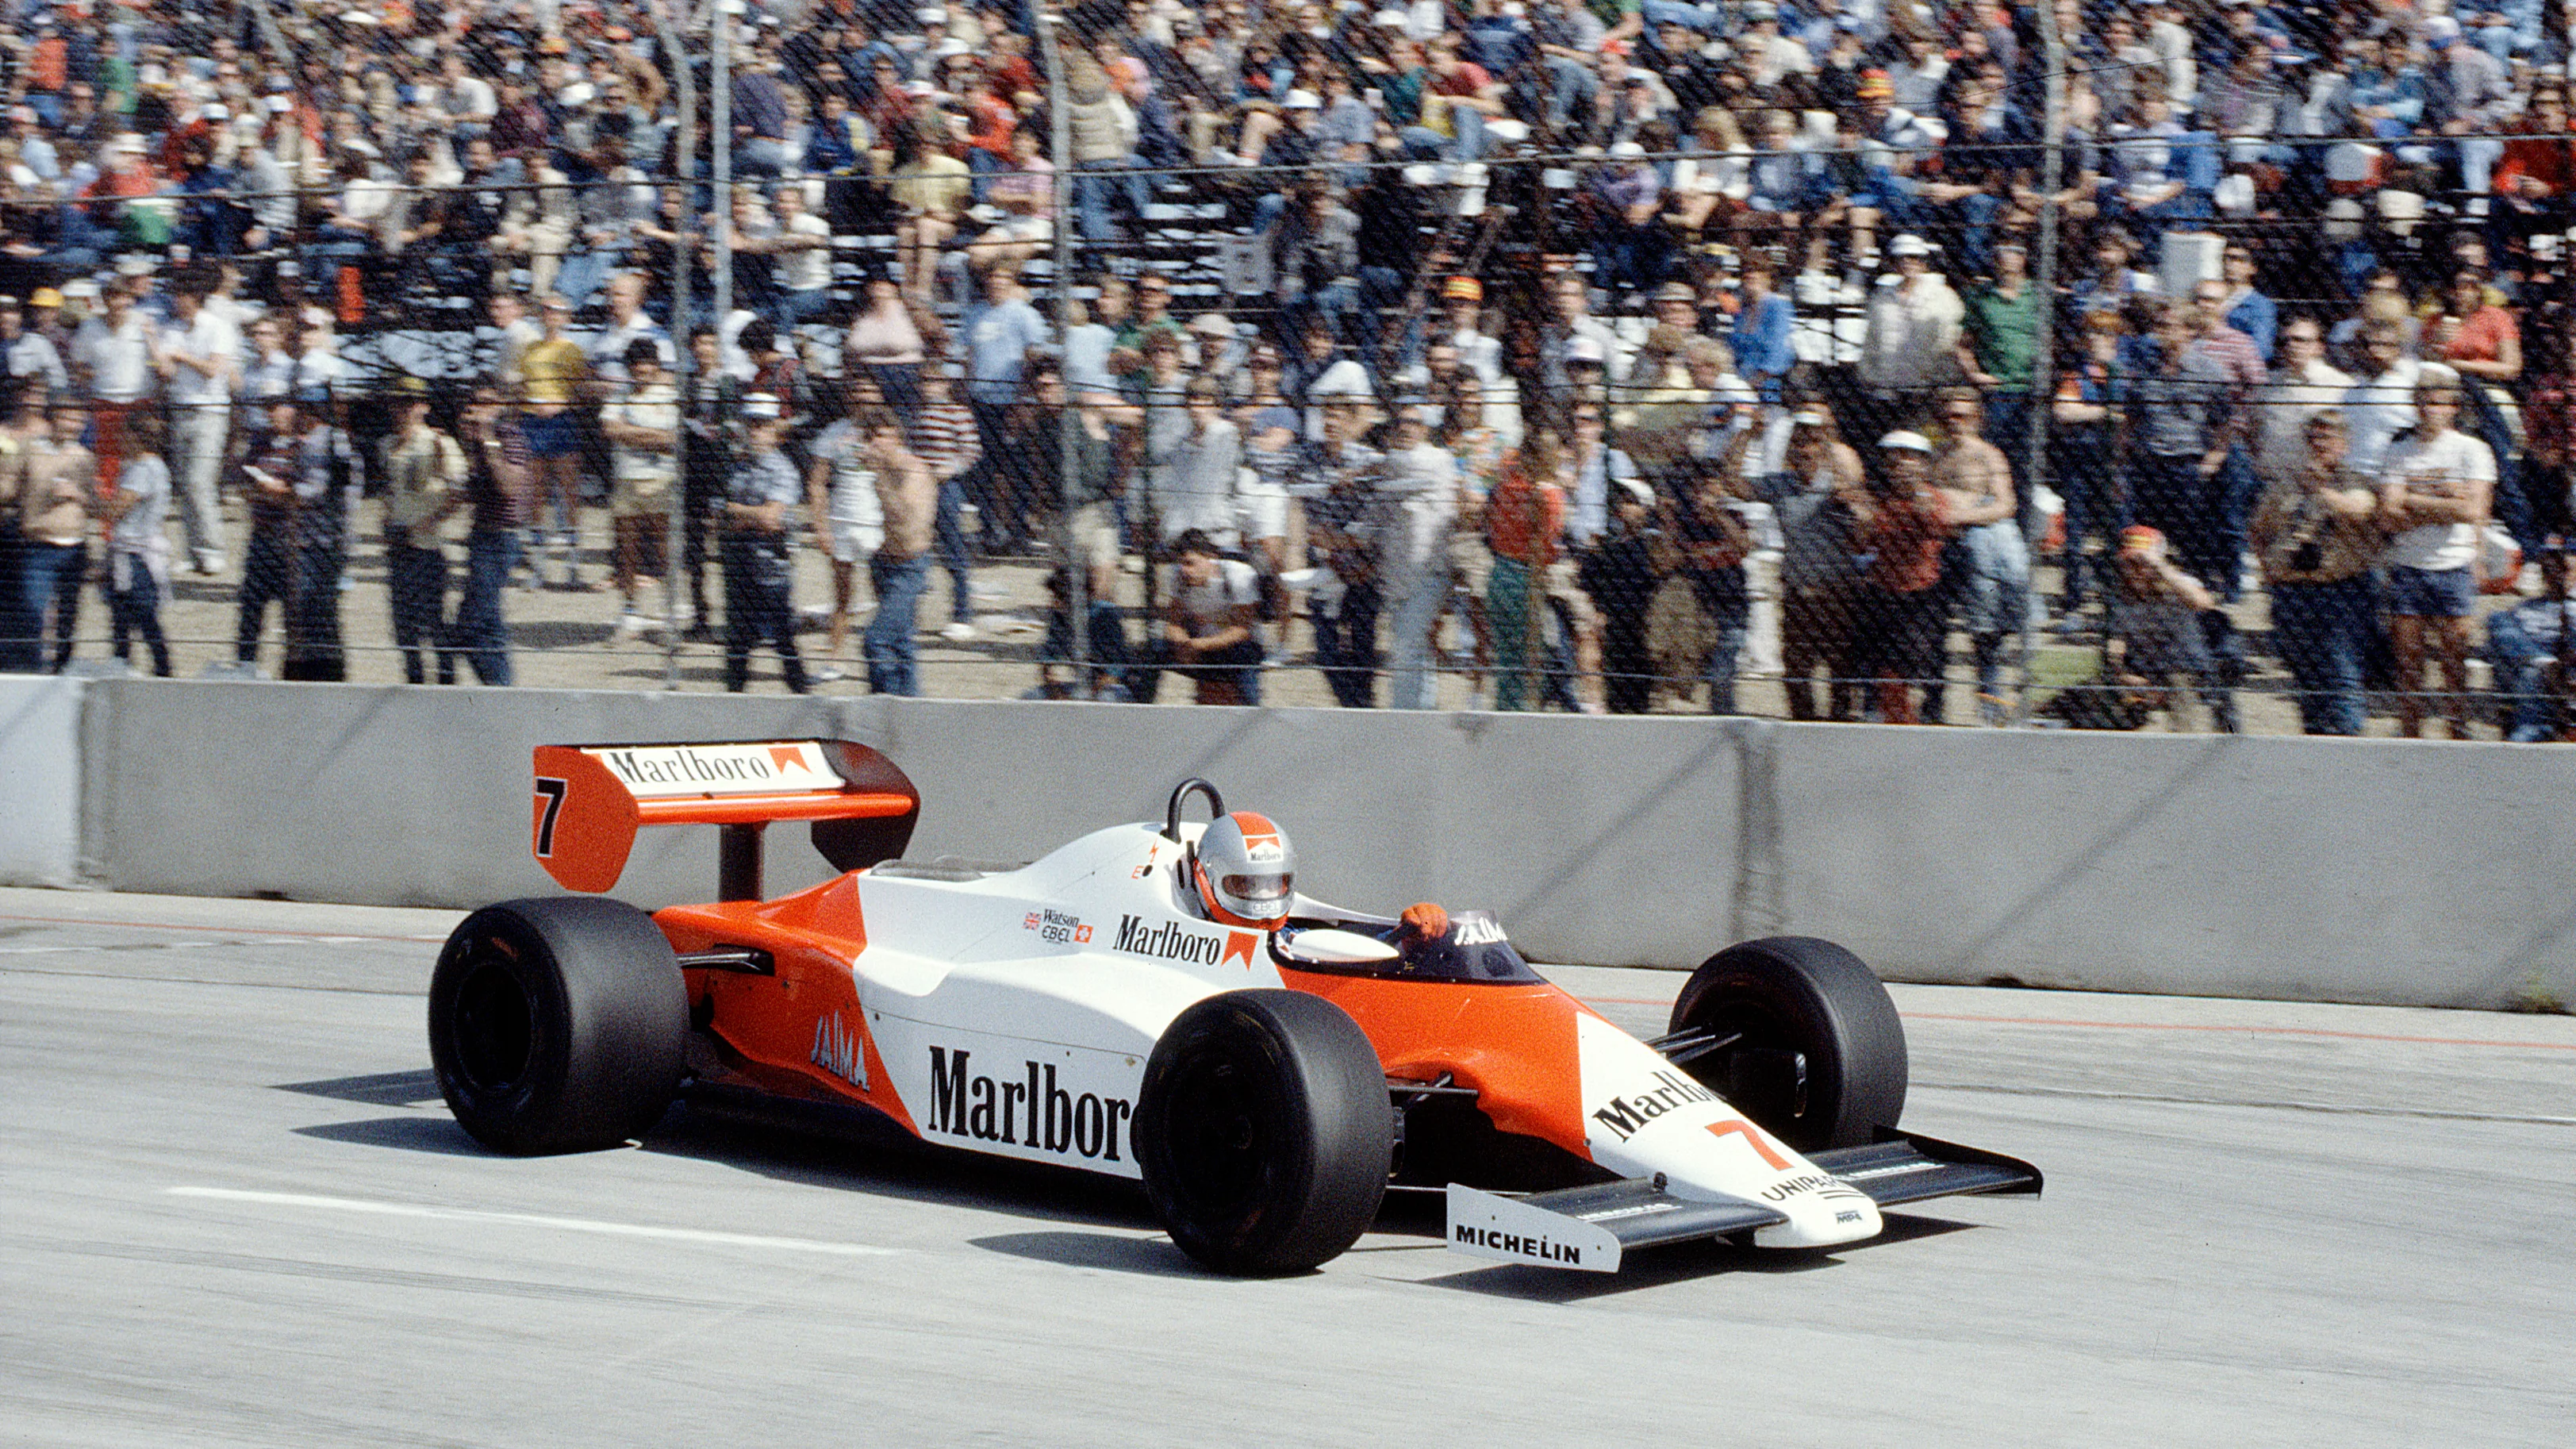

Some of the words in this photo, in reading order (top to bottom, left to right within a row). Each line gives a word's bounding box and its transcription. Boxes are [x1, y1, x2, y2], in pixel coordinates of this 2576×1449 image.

[608, 750, 770, 783] Marlboro
[535, 777, 567, 857] 7
[1250, 849, 1280, 862] Marlboro
[1043, 909, 1079, 928] Watson
[1112, 913, 1221, 966] Marlboro
[1591, 1070, 1721, 1143] Marlb
[1704, 1119, 1795, 1172] 7
[1760, 1175, 1851, 1201] UNIPAR
[1456, 1224, 1581, 1264] MICHELIN
